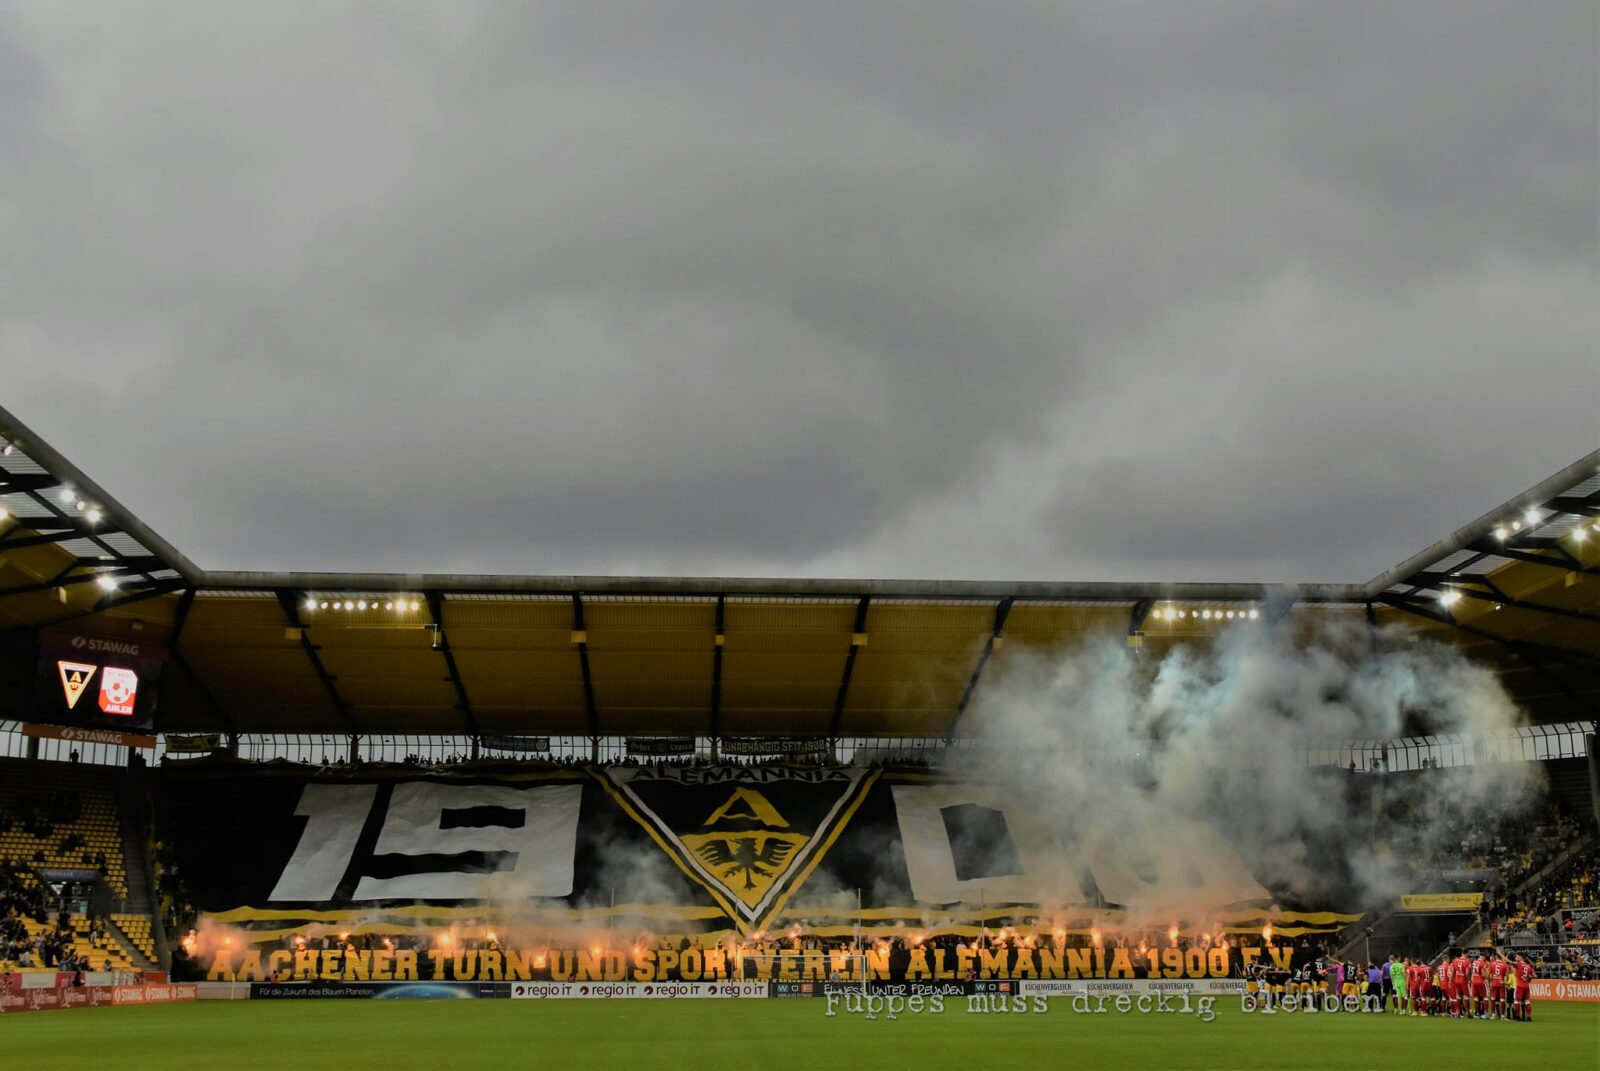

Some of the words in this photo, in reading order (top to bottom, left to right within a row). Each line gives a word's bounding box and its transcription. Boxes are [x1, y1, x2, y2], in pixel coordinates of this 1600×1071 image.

[89, 640, 139, 655] STAWAG
[106, 704, 133, 714] AHLEN
[75, 731, 122, 744] STAWAG
[726, 741, 780, 753] UNABHÄNGIG
[782, 741, 804, 752] SEIT
[631, 768, 851, 785] ALEMANNIA
[206, 949, 419, 981] AACHENER
[549, 949, 627, 981] UND
[905, 948, 1134, 979] ALEMANNIA
[1147, 946, 1230, 978] 1900
[1495, 964, 1501, 975] 6
[259, 987, 271, 996] Für
[283, 987, 307, 996] Zukunft
[308, 987, 321, 996] des
[322, 987, 344, 996] Blauen
[527, 985, 560, 999] regio
[592, 985, 625, 999] regio
[656, 985, 688, 999] regio
[720, 986, 751, 999] rego
[871, 984, 907, 996] UNTER
[911, 983, 965, 996] FREUNDEN
[1025, 983, 1072, 992] KÜCHENVERGLEICH
[1087, 982, 1134, 991] KÜCHENVERGLEICH
[1148, 982, 1195, 991] KÜCHENVERGLEICH
